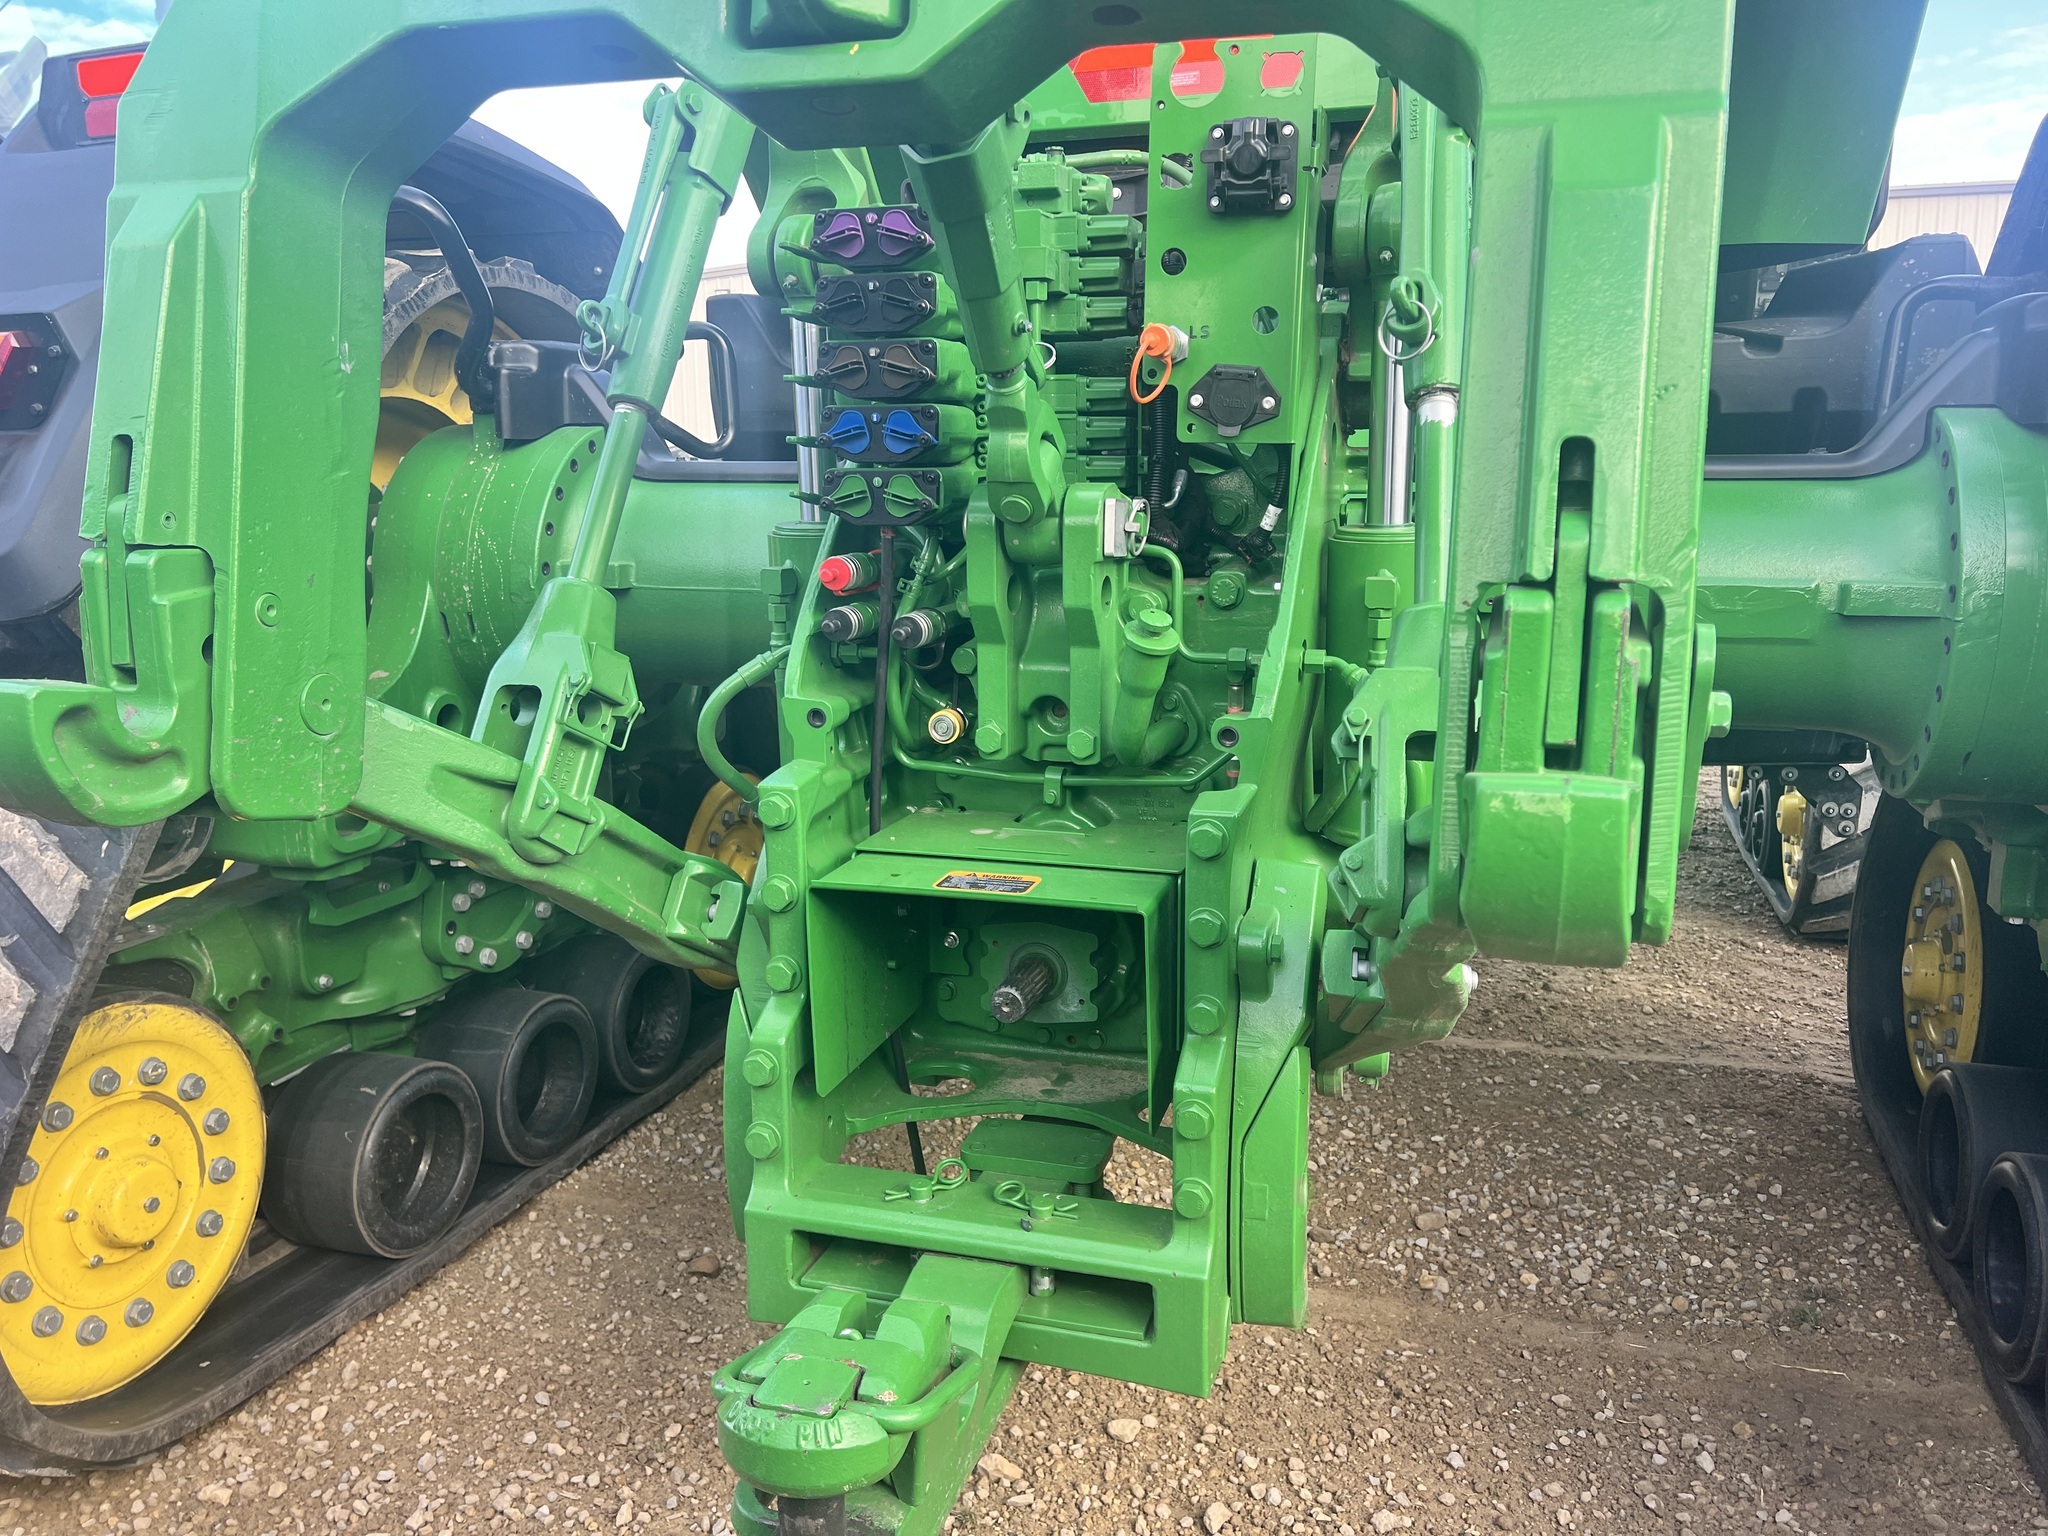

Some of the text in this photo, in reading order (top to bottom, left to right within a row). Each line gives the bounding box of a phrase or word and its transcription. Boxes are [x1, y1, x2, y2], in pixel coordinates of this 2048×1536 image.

[1189, 325, 1210, 339] LS
[1217, 395, 1247, 409] Pollak
[1144, 799, 1155, 808] IN
[1159, 800, 1175, 808] USA
[796, 1418, 843, 1448] PIN
